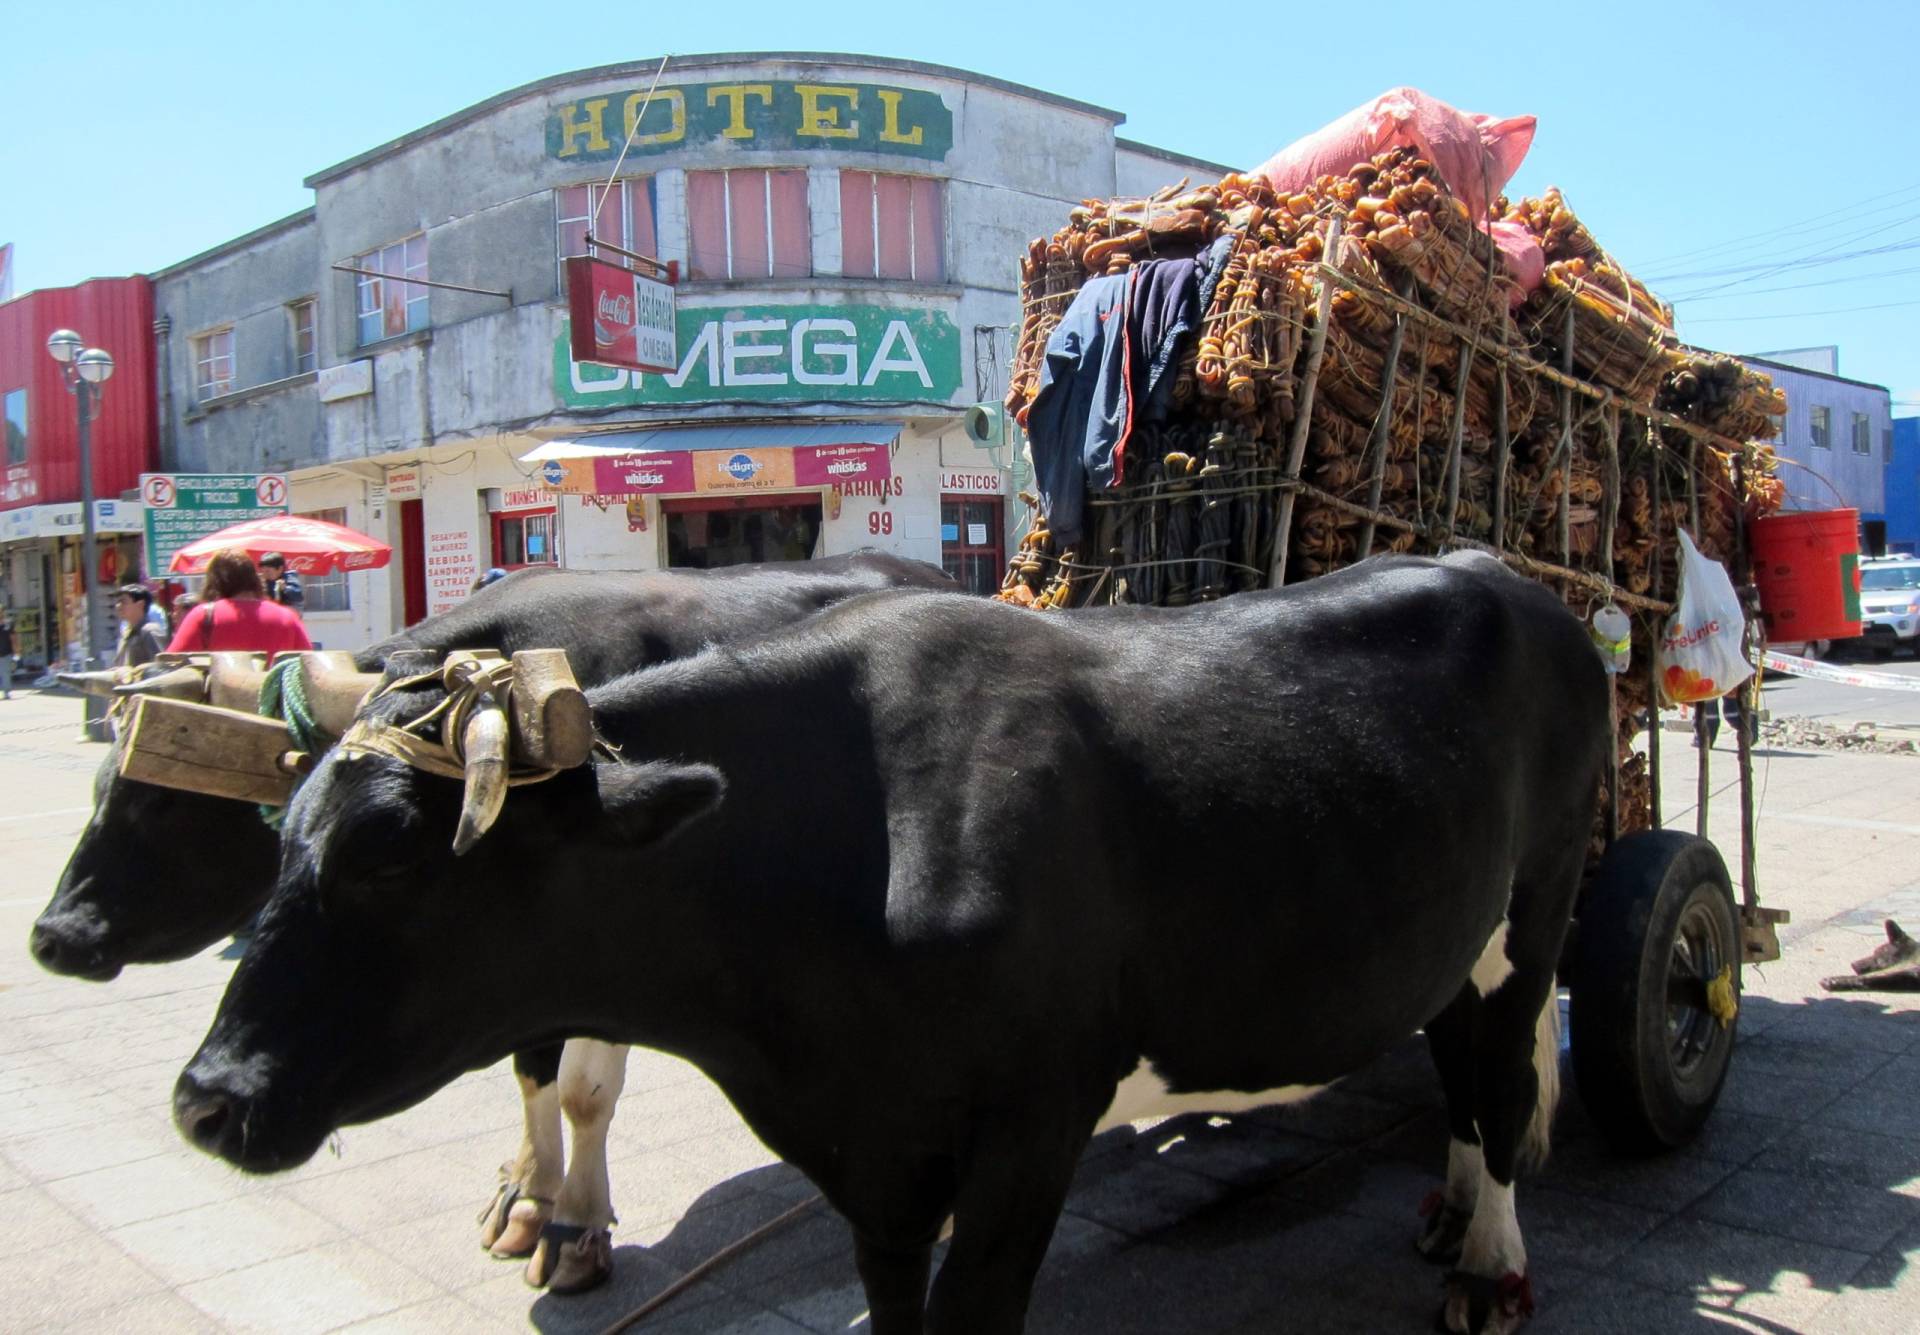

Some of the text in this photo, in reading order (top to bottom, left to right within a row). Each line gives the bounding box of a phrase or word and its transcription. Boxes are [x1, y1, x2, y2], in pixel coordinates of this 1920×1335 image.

[558, 84, 923, 158] HOTEL
[642, 337, 673, 361] OMEGA
[718, 459, 764, 473] Pedigree
[827, 460, 867, 475] whiskas
[625, 470, 664, 484] whiskas
[939, 474, 998, 490] LASTICOS
[832, 475, 903, 497] HARINAS
[869, 511, 893, 535] 99
[431, 532, 468, 542] DESAYUNO
[432, 543, 468, 552] ALMUERZO
[428, 555, 473, 565] BEBIDAS
[428, 567, 475, 577] SANDWICH
[434, 577, 470, 587] EXTRAS
[438, 589, 465, 598] ONCES
